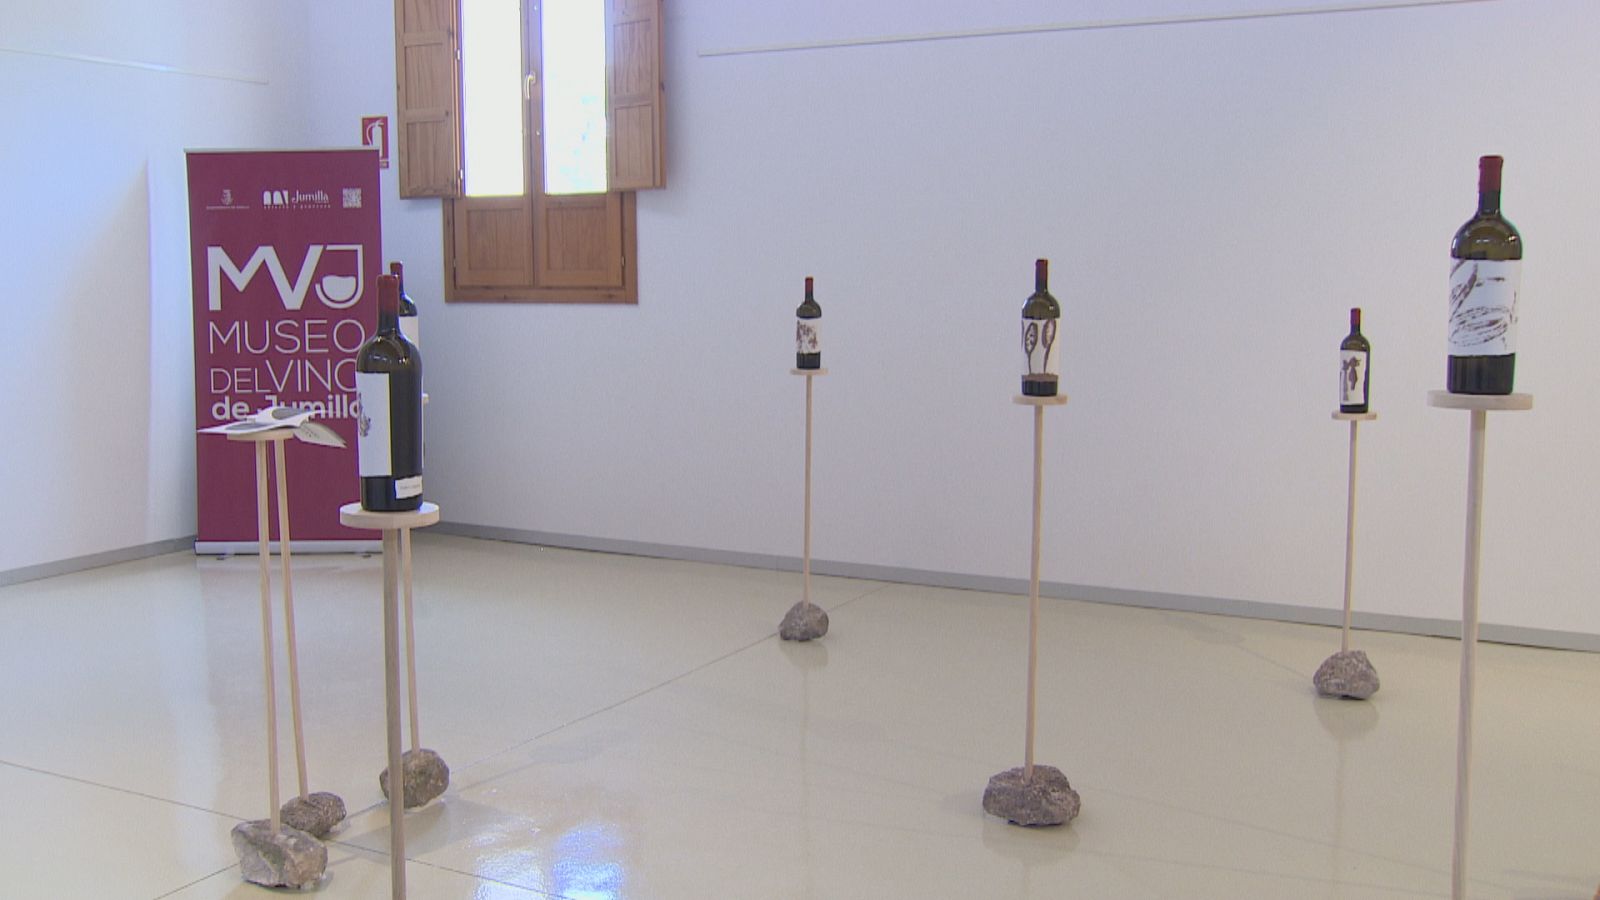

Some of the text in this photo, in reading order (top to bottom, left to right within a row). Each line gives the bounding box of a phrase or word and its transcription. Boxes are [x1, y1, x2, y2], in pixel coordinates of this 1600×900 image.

[292, 189, 329, 204] Jumilla
[207, 244, 364, 311] MVJ
[209, 319, 366, 354] MUSEO
[212, 395, 249, 420] de
